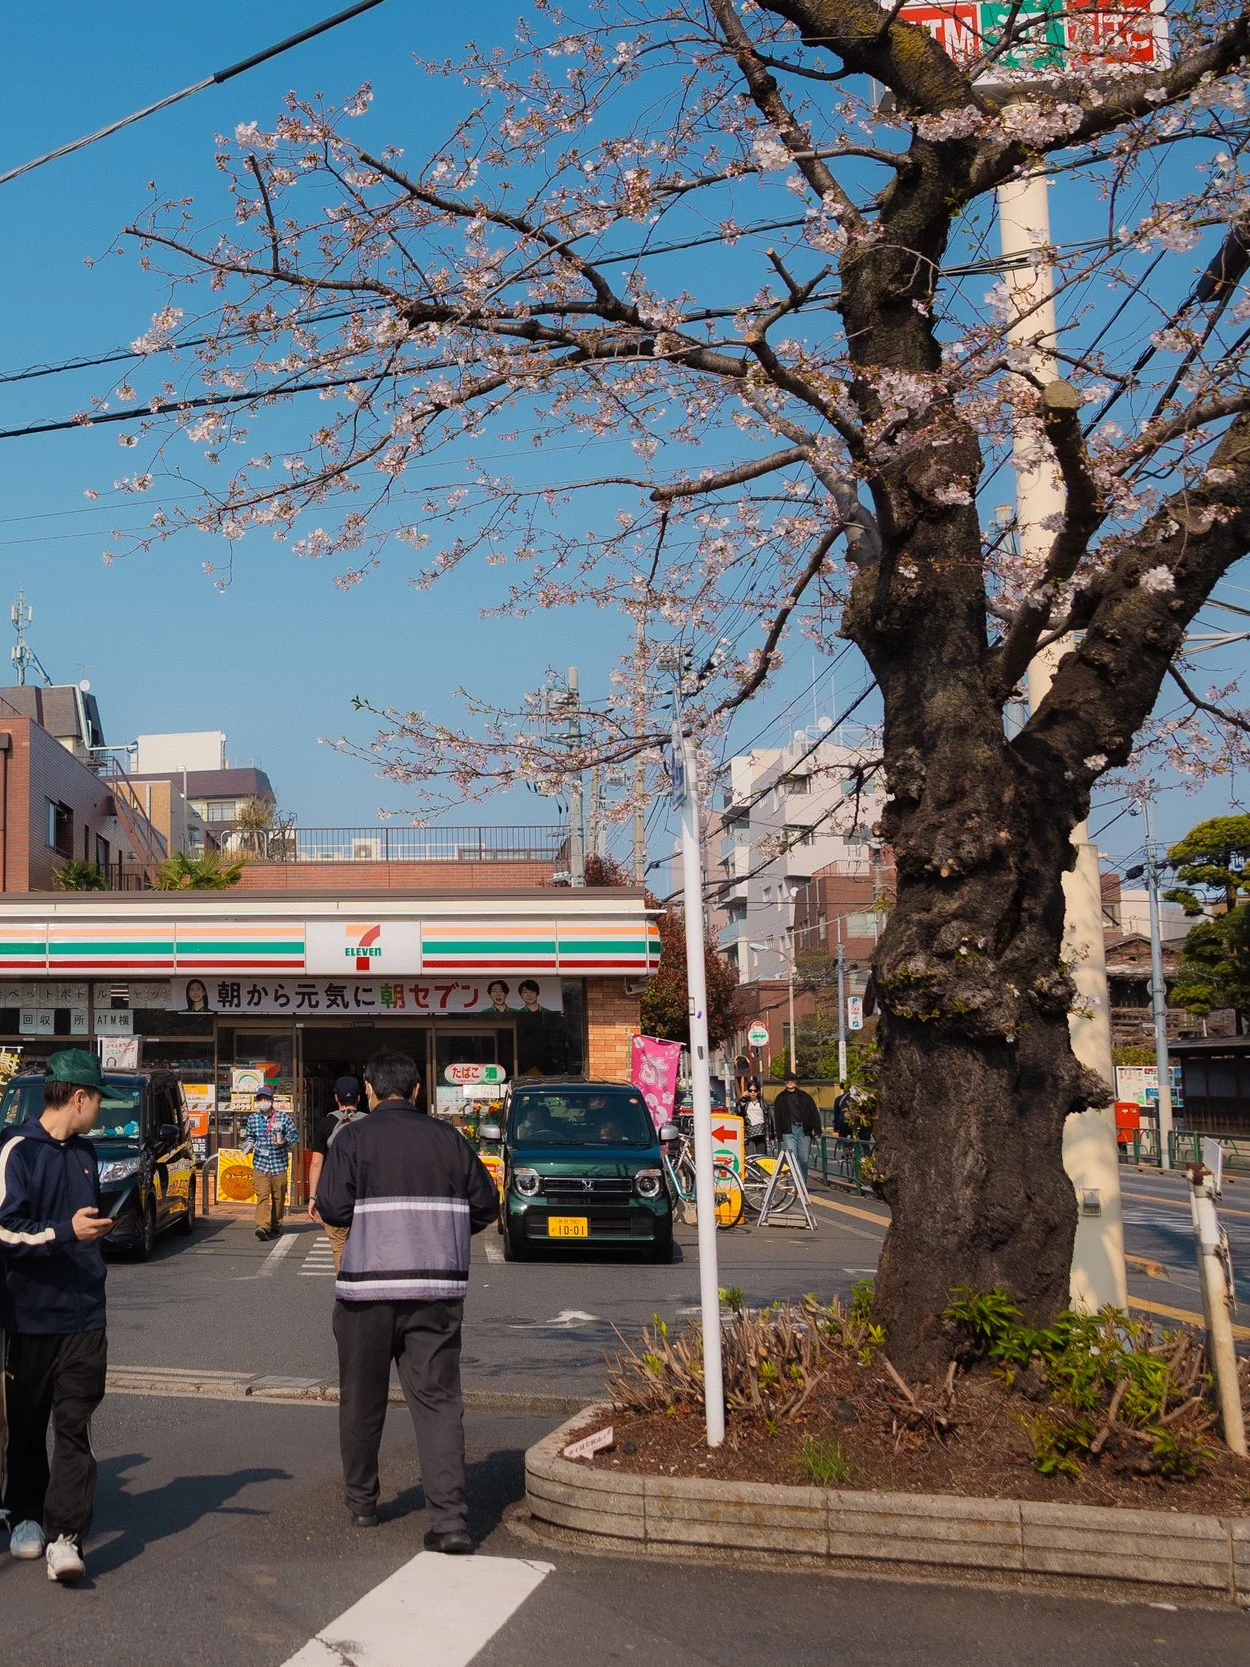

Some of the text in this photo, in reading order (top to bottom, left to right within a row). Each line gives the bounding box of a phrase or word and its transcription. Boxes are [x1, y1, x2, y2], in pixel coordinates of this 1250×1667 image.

[217, 980, 479, 1009] 朝から元気に朝セブン
[23, 1014, 51, 1026] 回収
[452, 1066, 497, 1079] たばこ 酒
[558, 1225, 584, 1235] 10-01
